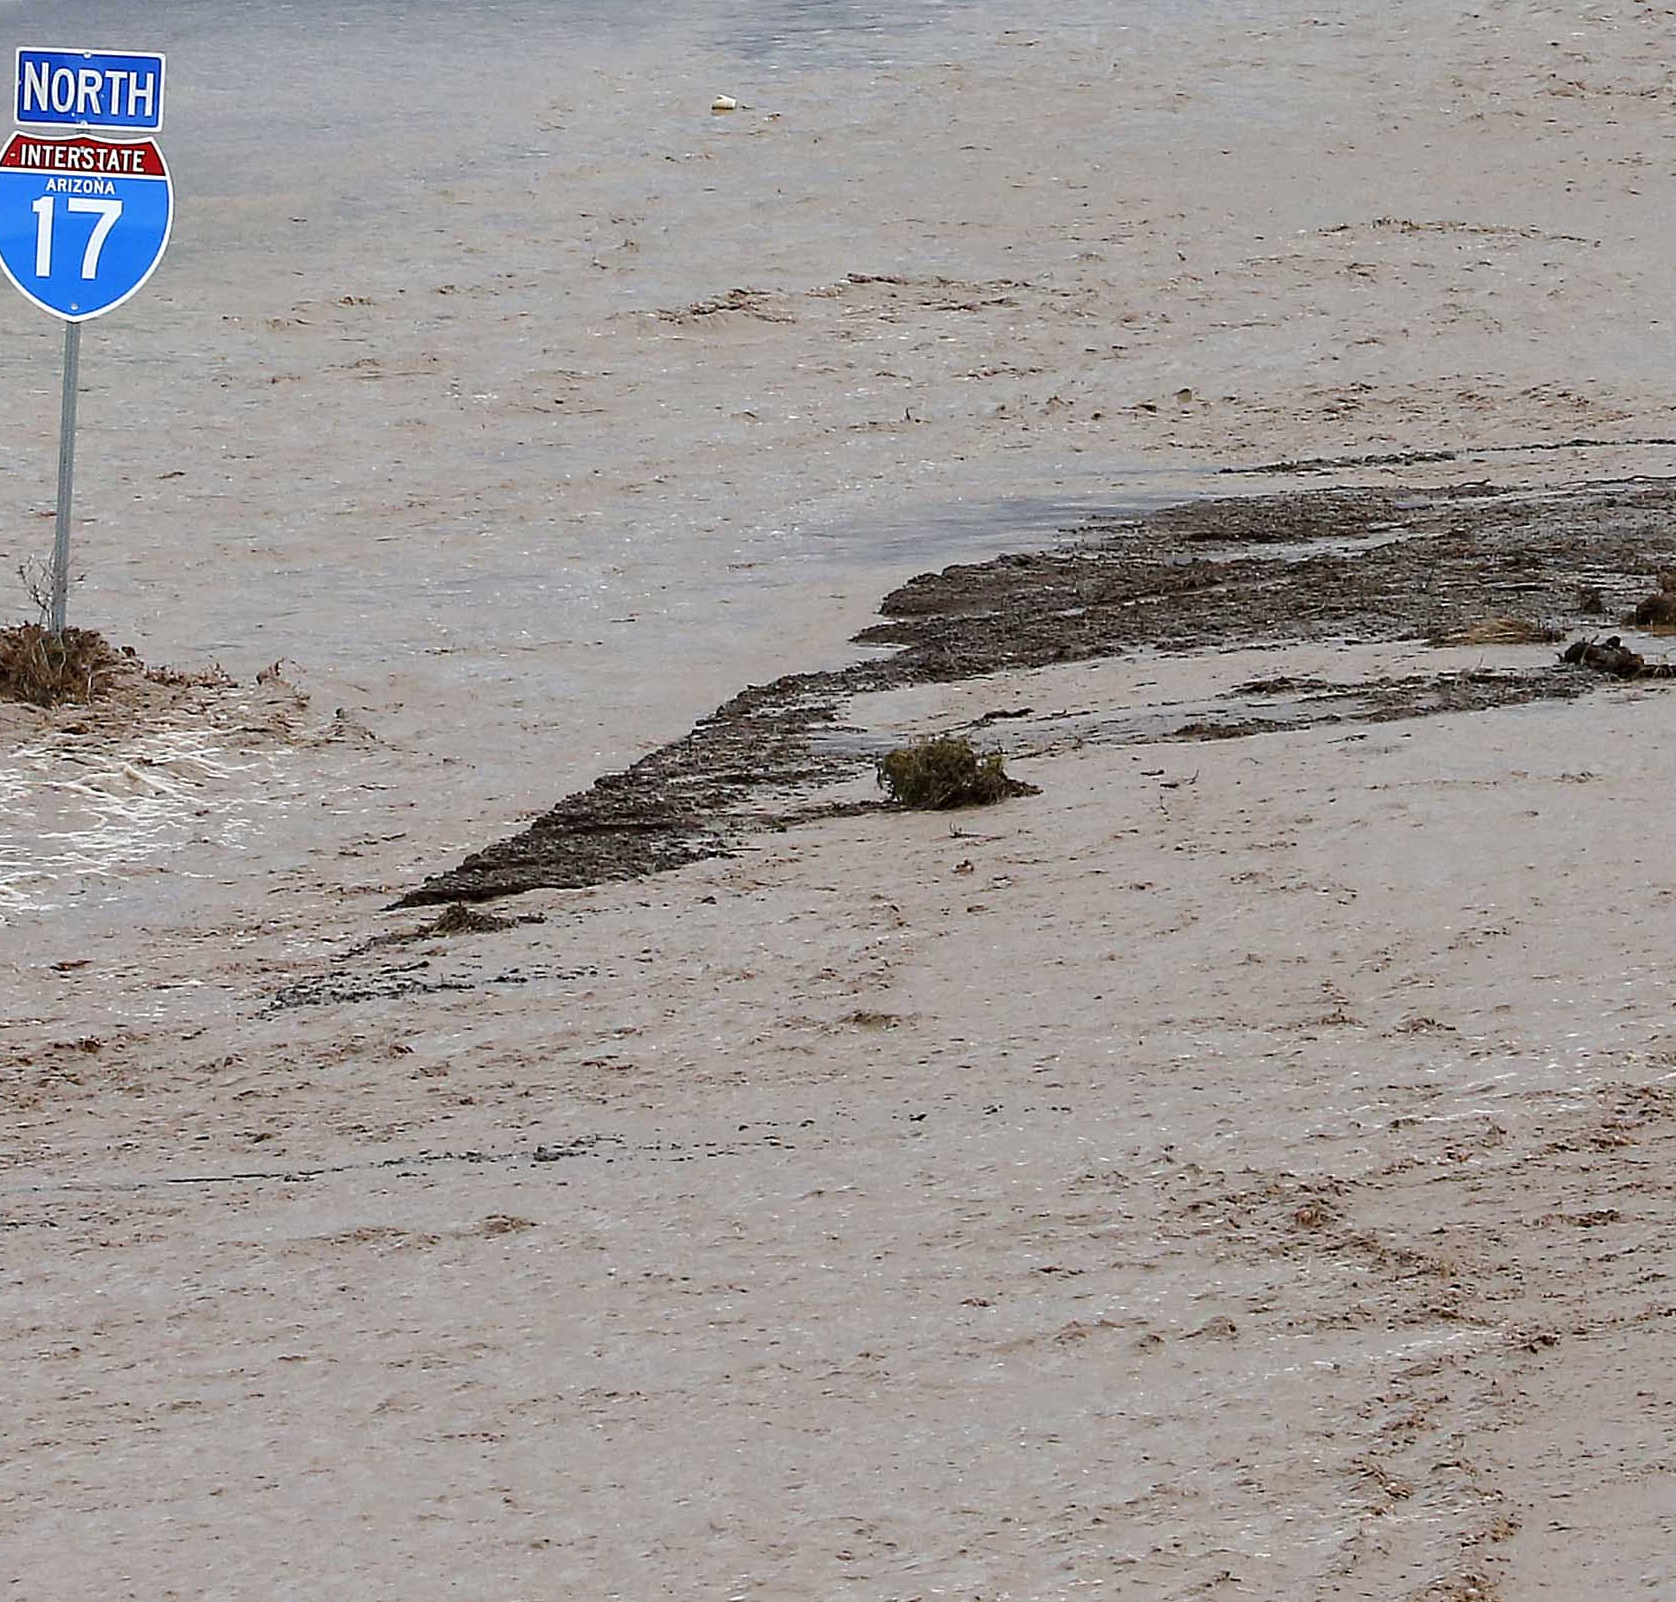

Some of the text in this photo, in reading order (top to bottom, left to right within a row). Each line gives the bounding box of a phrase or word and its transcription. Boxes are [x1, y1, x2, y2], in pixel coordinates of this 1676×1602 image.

[23, 61, 155, 117] NORTH
[20, 144, 145, 173] INTERSTATE
[45, 178, 116, 195] ARIZONA
[32, 196, 123, 280] 17
